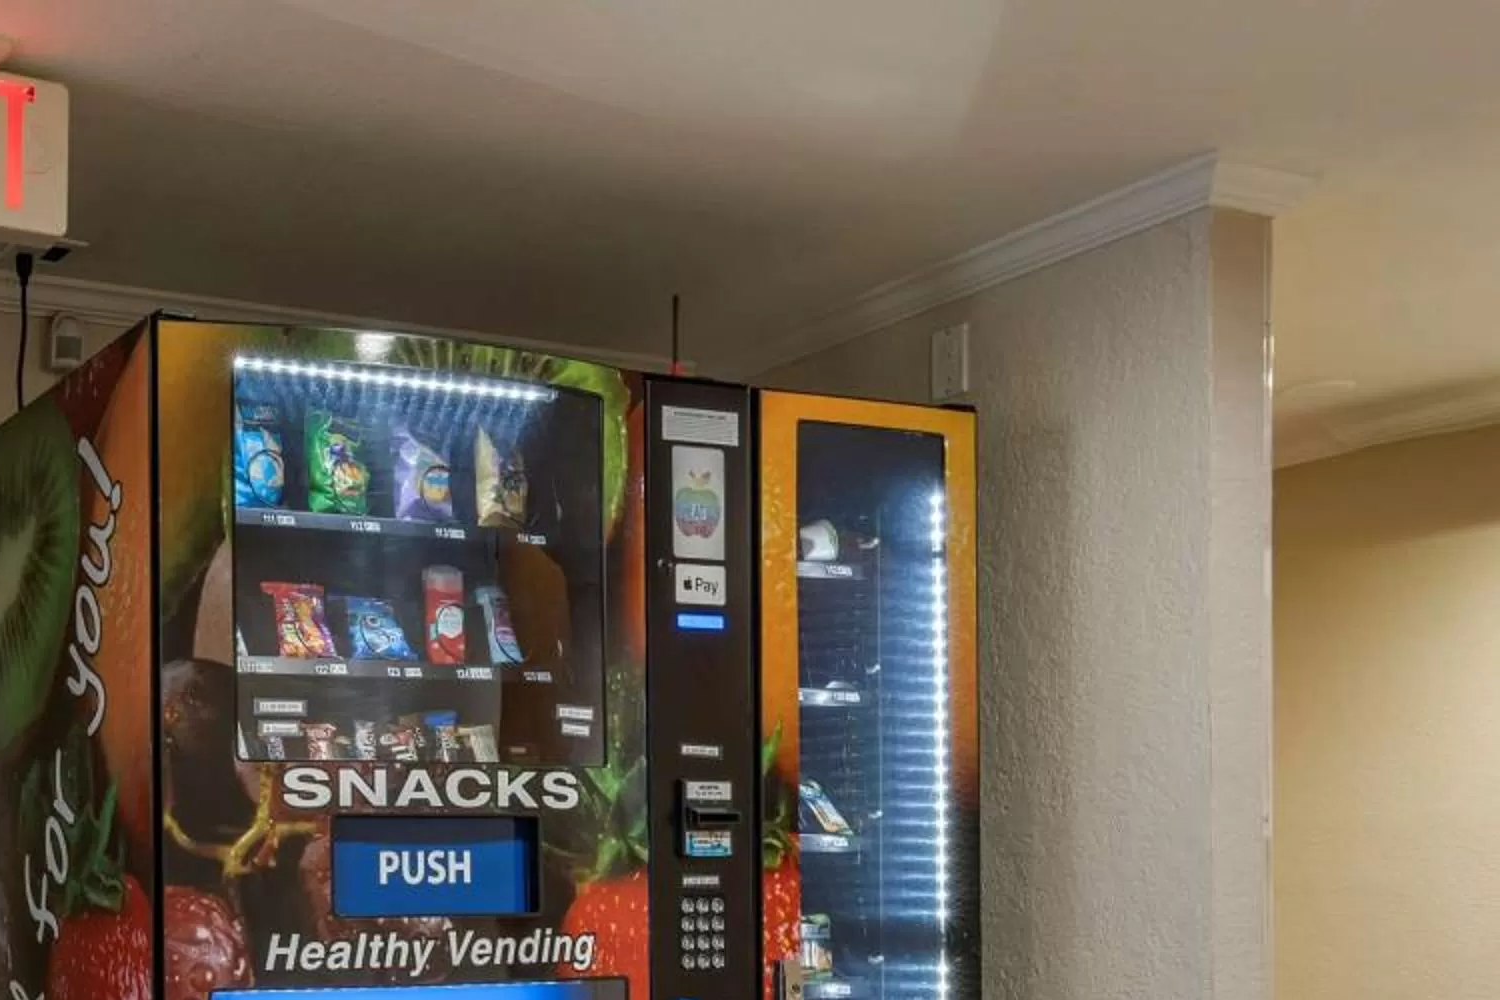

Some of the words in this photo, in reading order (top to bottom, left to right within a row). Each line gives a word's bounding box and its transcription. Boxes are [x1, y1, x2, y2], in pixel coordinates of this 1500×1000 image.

[695, 577, 719, 597] Pay
[24, 746, 76, 945] for
[67, 435, 122, 737] you!
[283, 767, 580, 810] SNACKS
[378, 848, 472, 886] PUSH
[264, 932, 440, 977] Healthy
[447, 928, 596, 971] Vending
